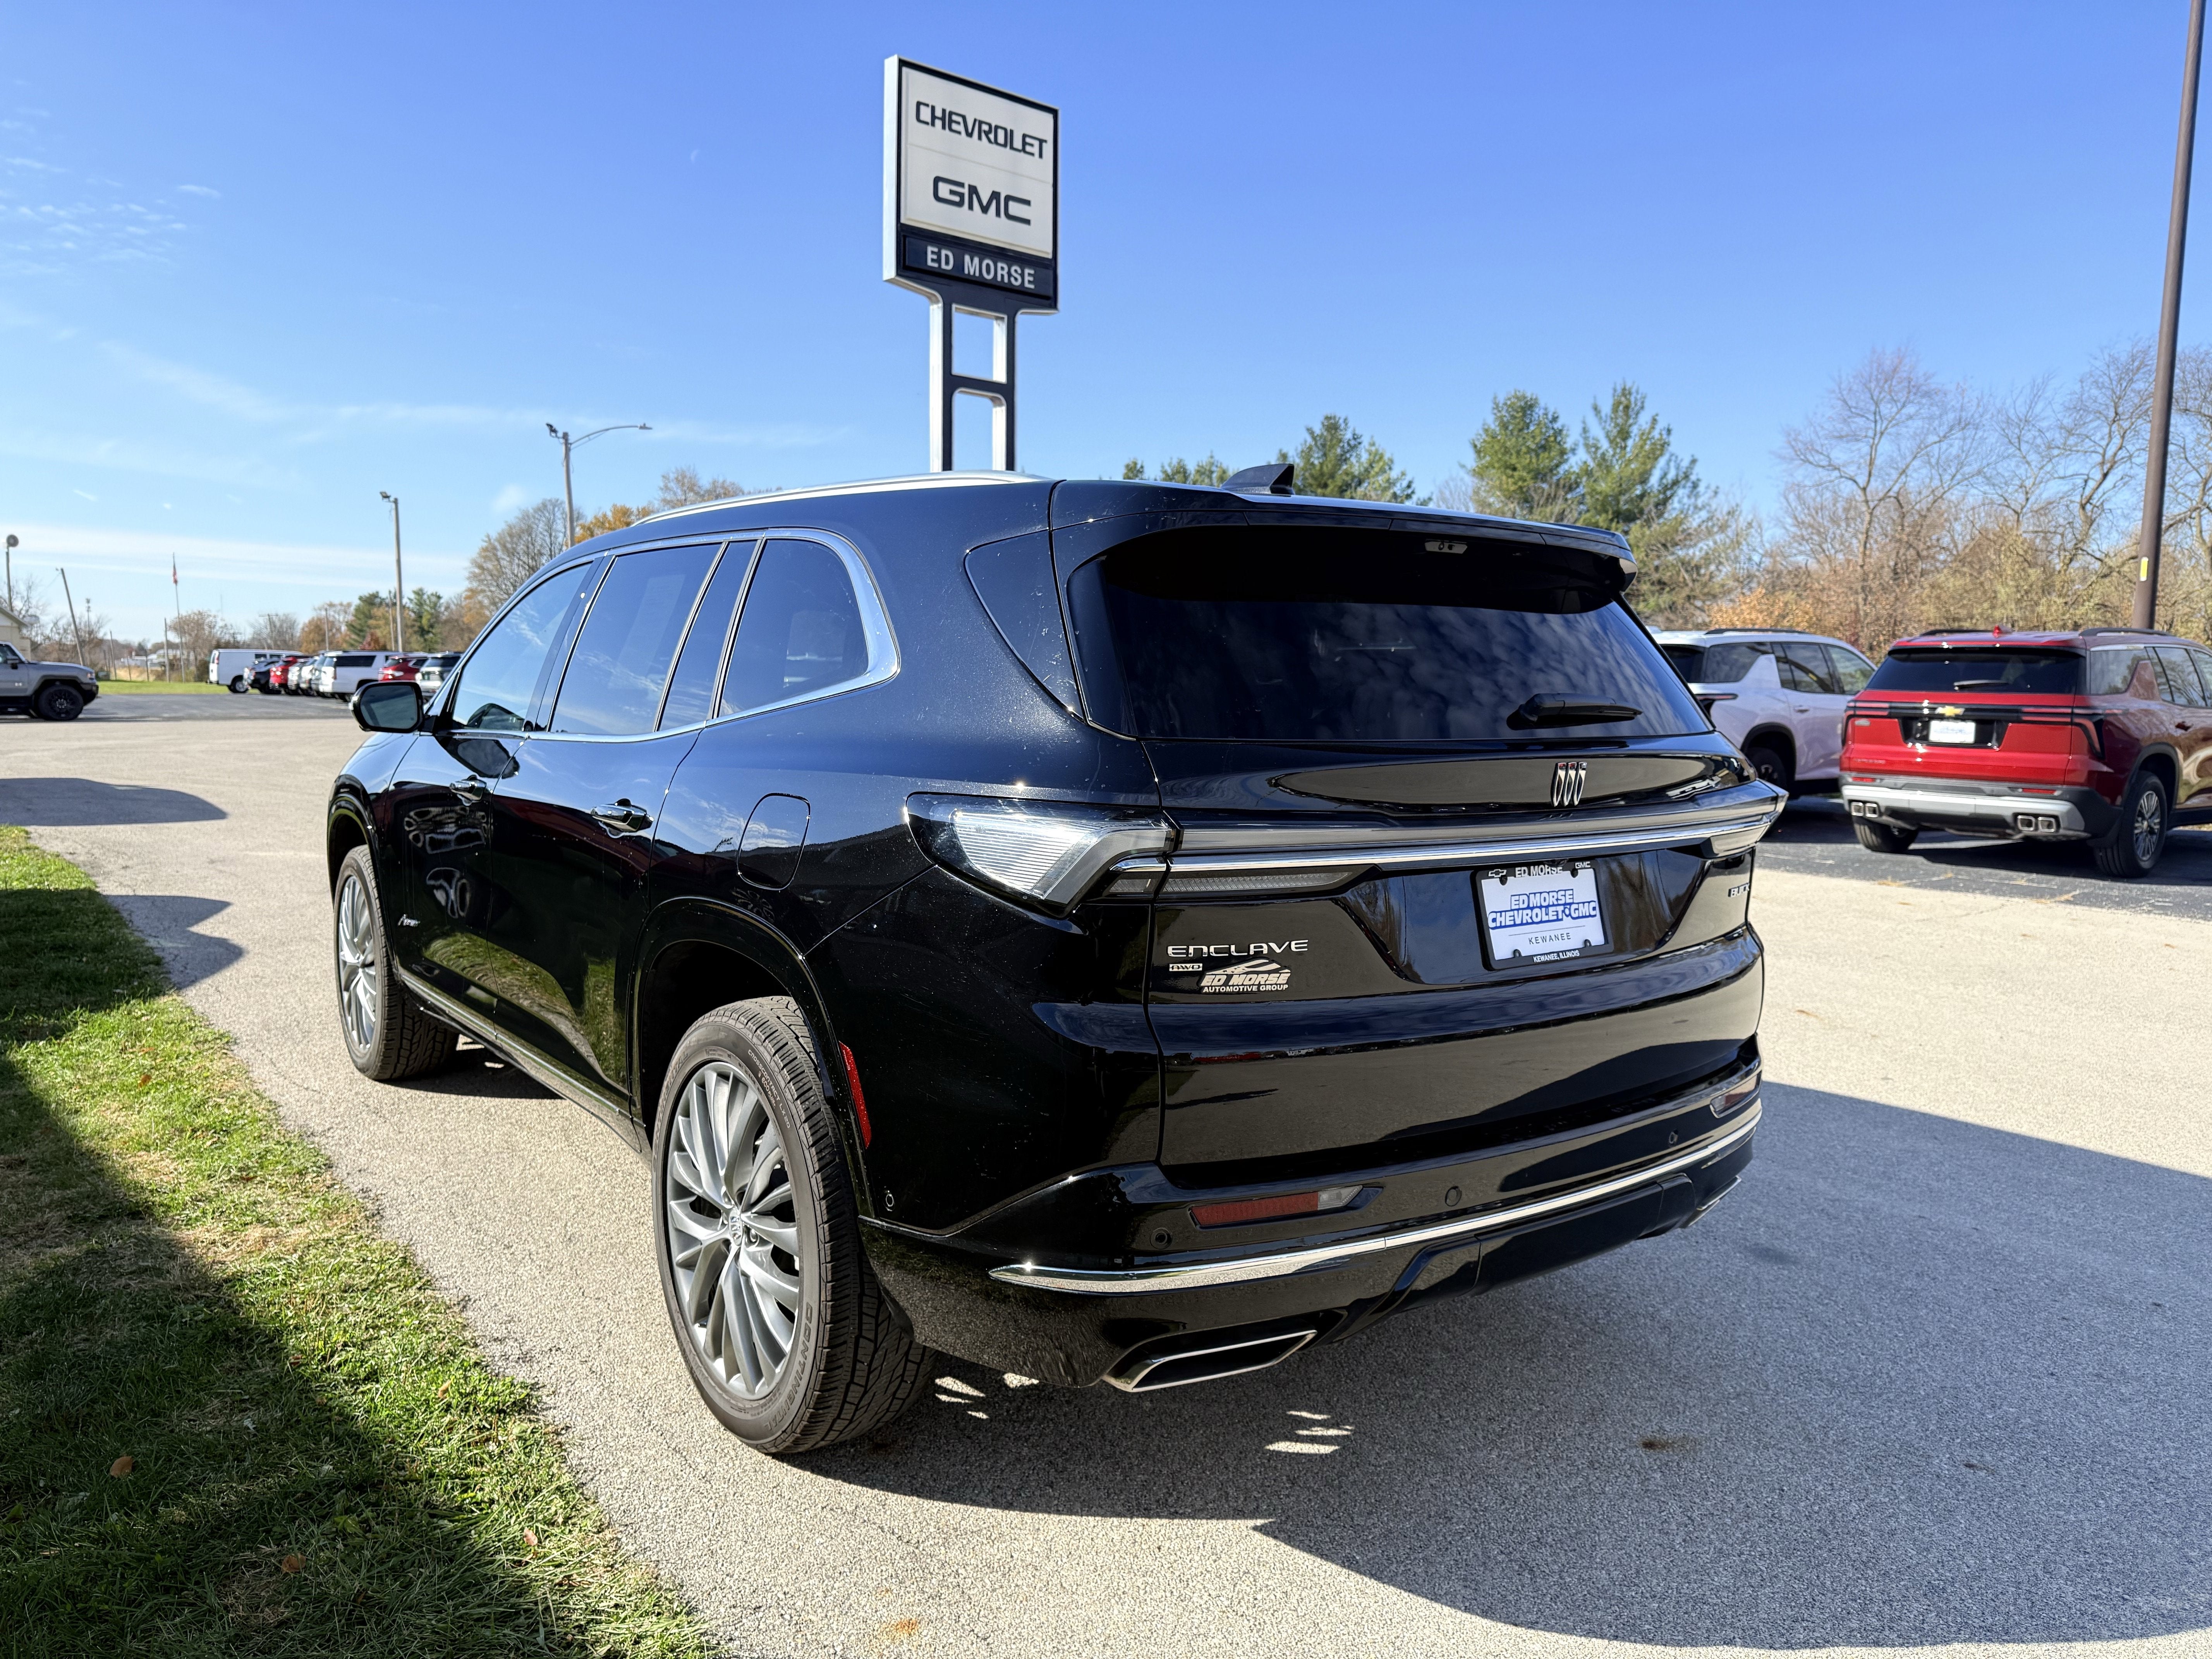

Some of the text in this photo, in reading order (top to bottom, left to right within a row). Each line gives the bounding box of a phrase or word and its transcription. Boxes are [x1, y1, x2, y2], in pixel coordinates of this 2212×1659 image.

[916, 101, 1047, 159] CHEVROLET
[933, 175, 1031, 226] GMC
[926, 246, 1036, 289] ED MORSE
[1515, 866, 1528, 878] ED
[1575, 861, 1591, 869] GMC
[1511, 889, 1574, 910] ED MORSE
[1528, 933, 1571, 945] KEWANEE
[1167, 939, 1309, 957] ENCLAVE
[1533, 950, 1580, 963] KEWANEE, ILLINOIS
[1200, 972, 1291, 986] ED MORSE
[1202, 985, 1258, 993] AUTOMOTIVE
